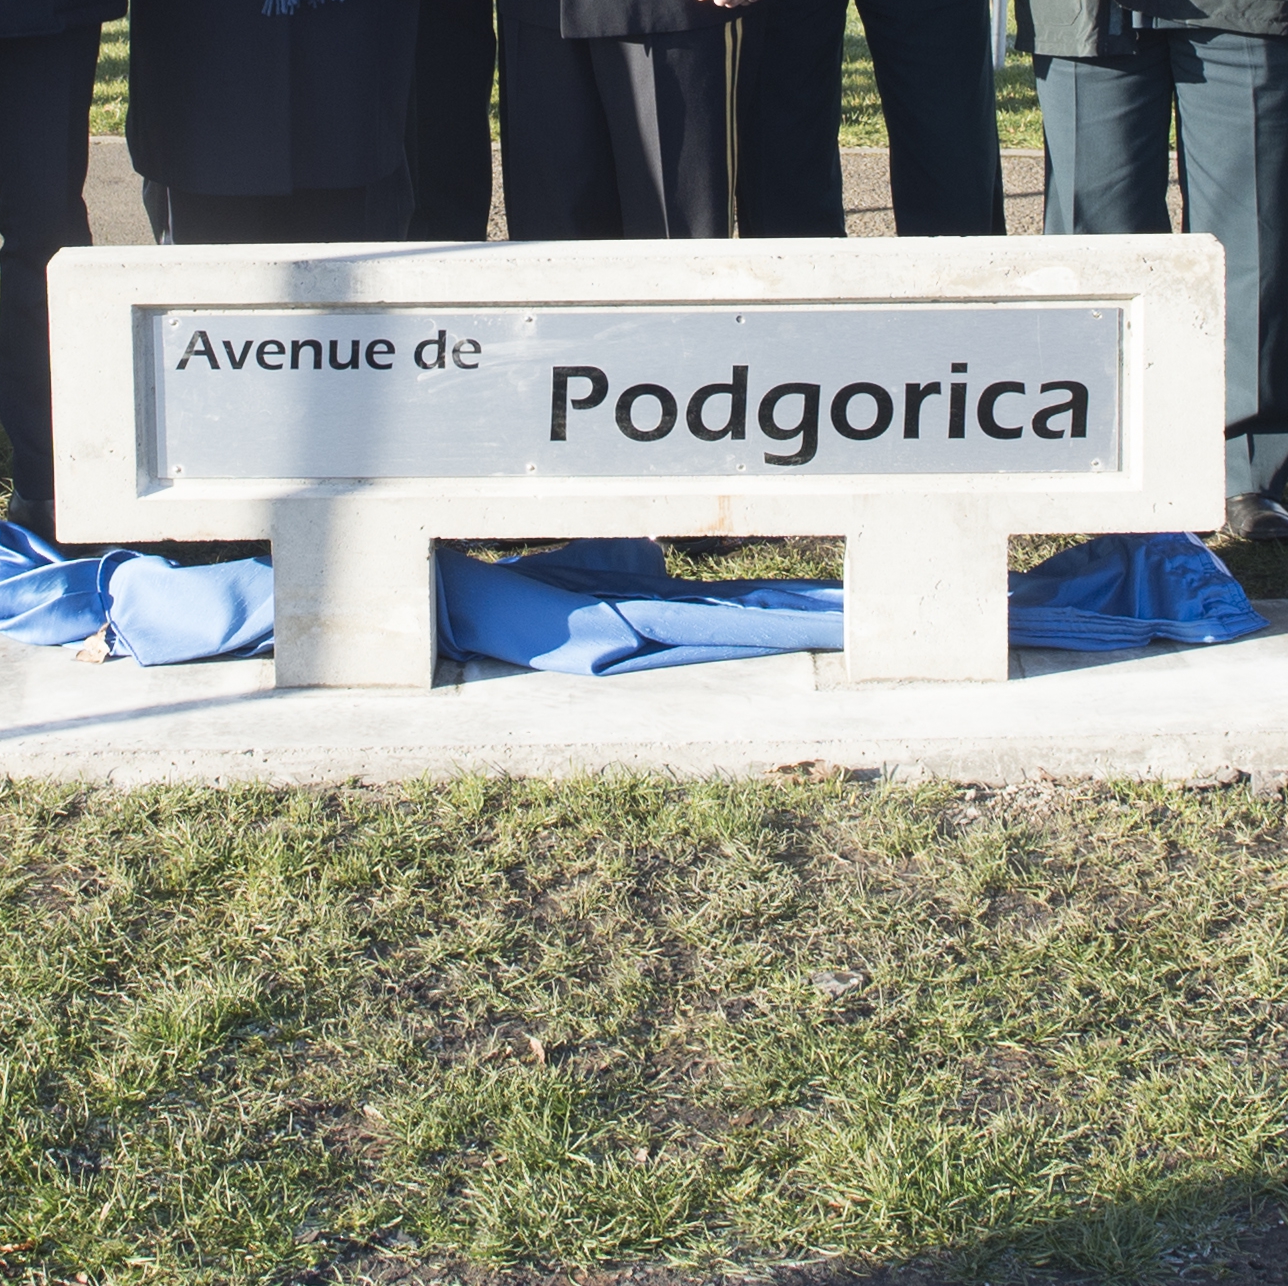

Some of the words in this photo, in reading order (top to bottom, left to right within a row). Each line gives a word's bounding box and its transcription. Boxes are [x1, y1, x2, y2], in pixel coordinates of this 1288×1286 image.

[175, 330, 396, 371] Avenue
[414, 330, 482, 370] de
[550, 365, 1089, 467] Podgorica
